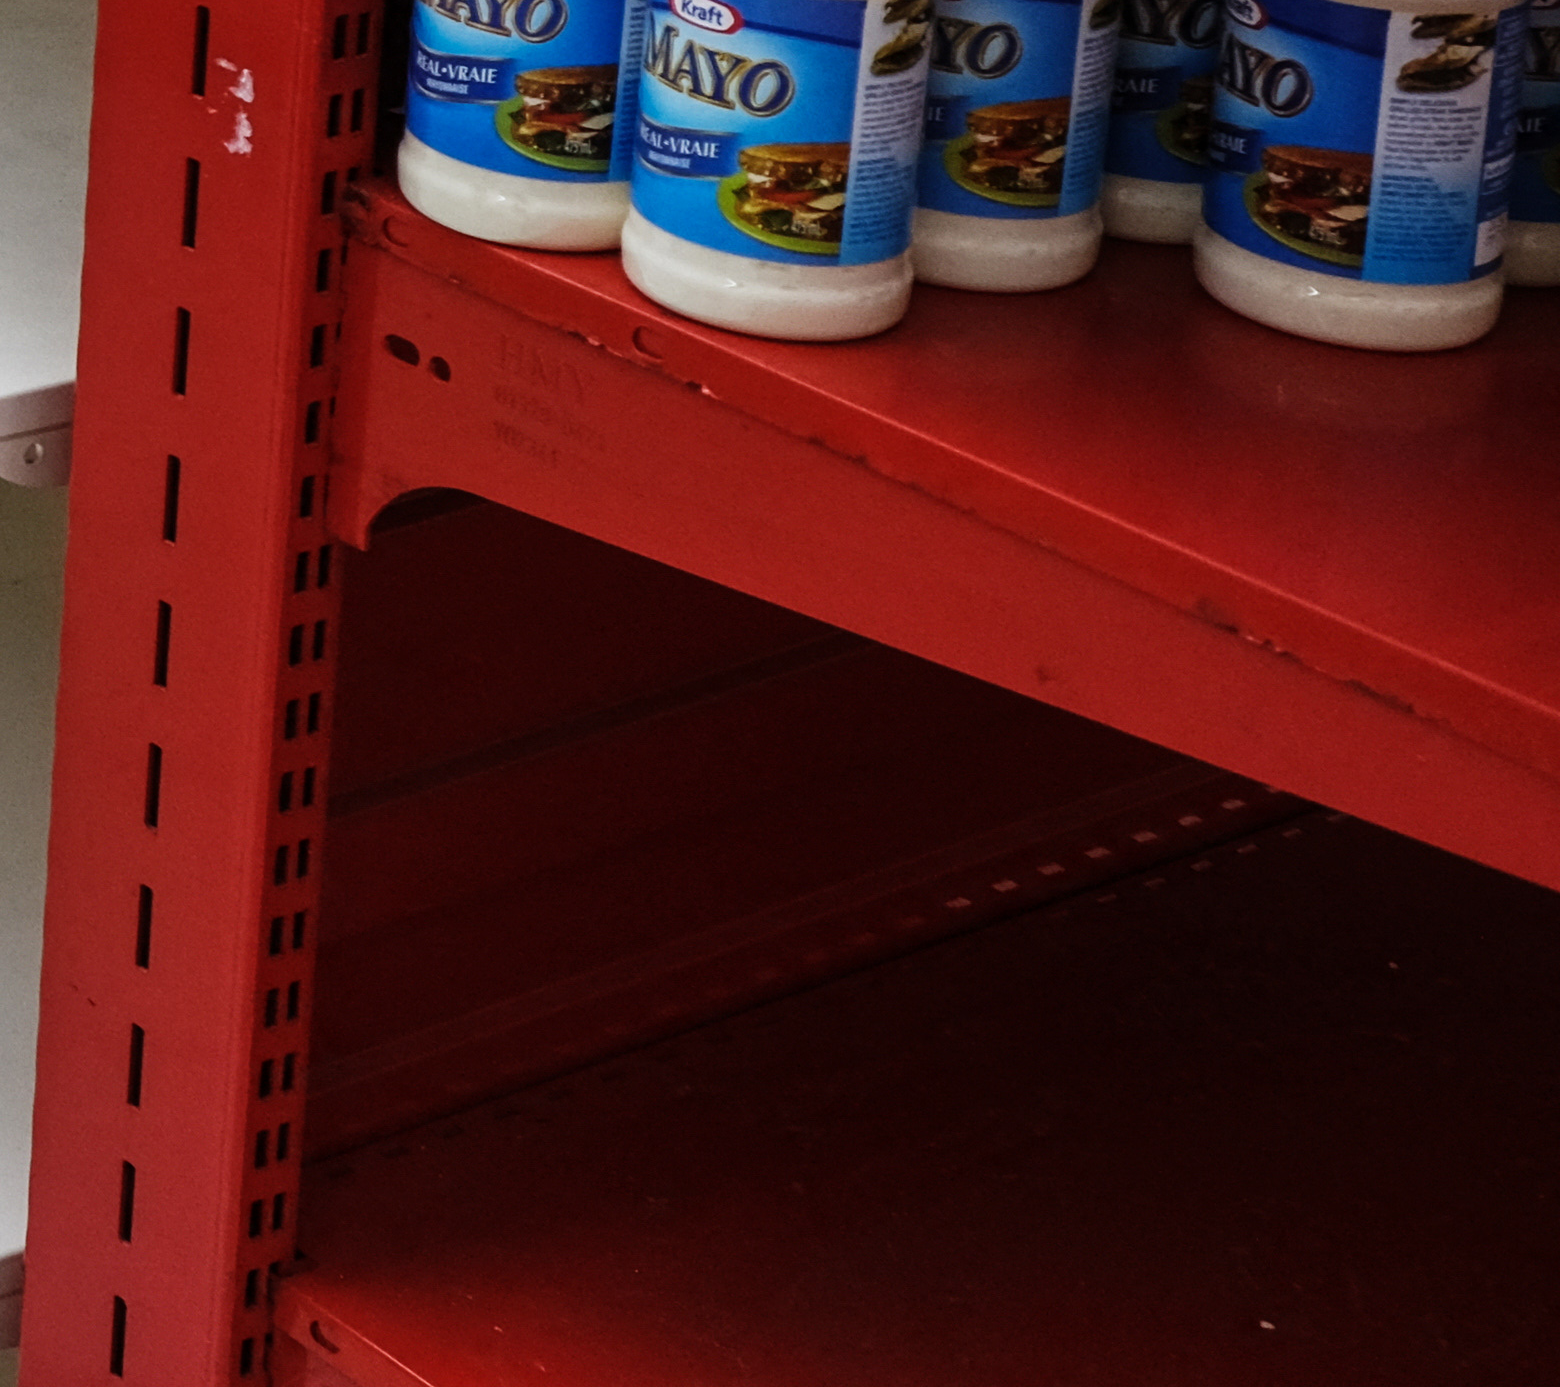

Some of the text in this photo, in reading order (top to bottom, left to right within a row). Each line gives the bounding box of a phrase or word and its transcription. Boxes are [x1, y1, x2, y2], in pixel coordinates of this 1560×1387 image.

[644, 14, 795, 118] MAYO
[928, 17, 1022, 80] YO
[447, 62, 497, 84] VRAIE
[670, 135, 720, 159] VRAIE
